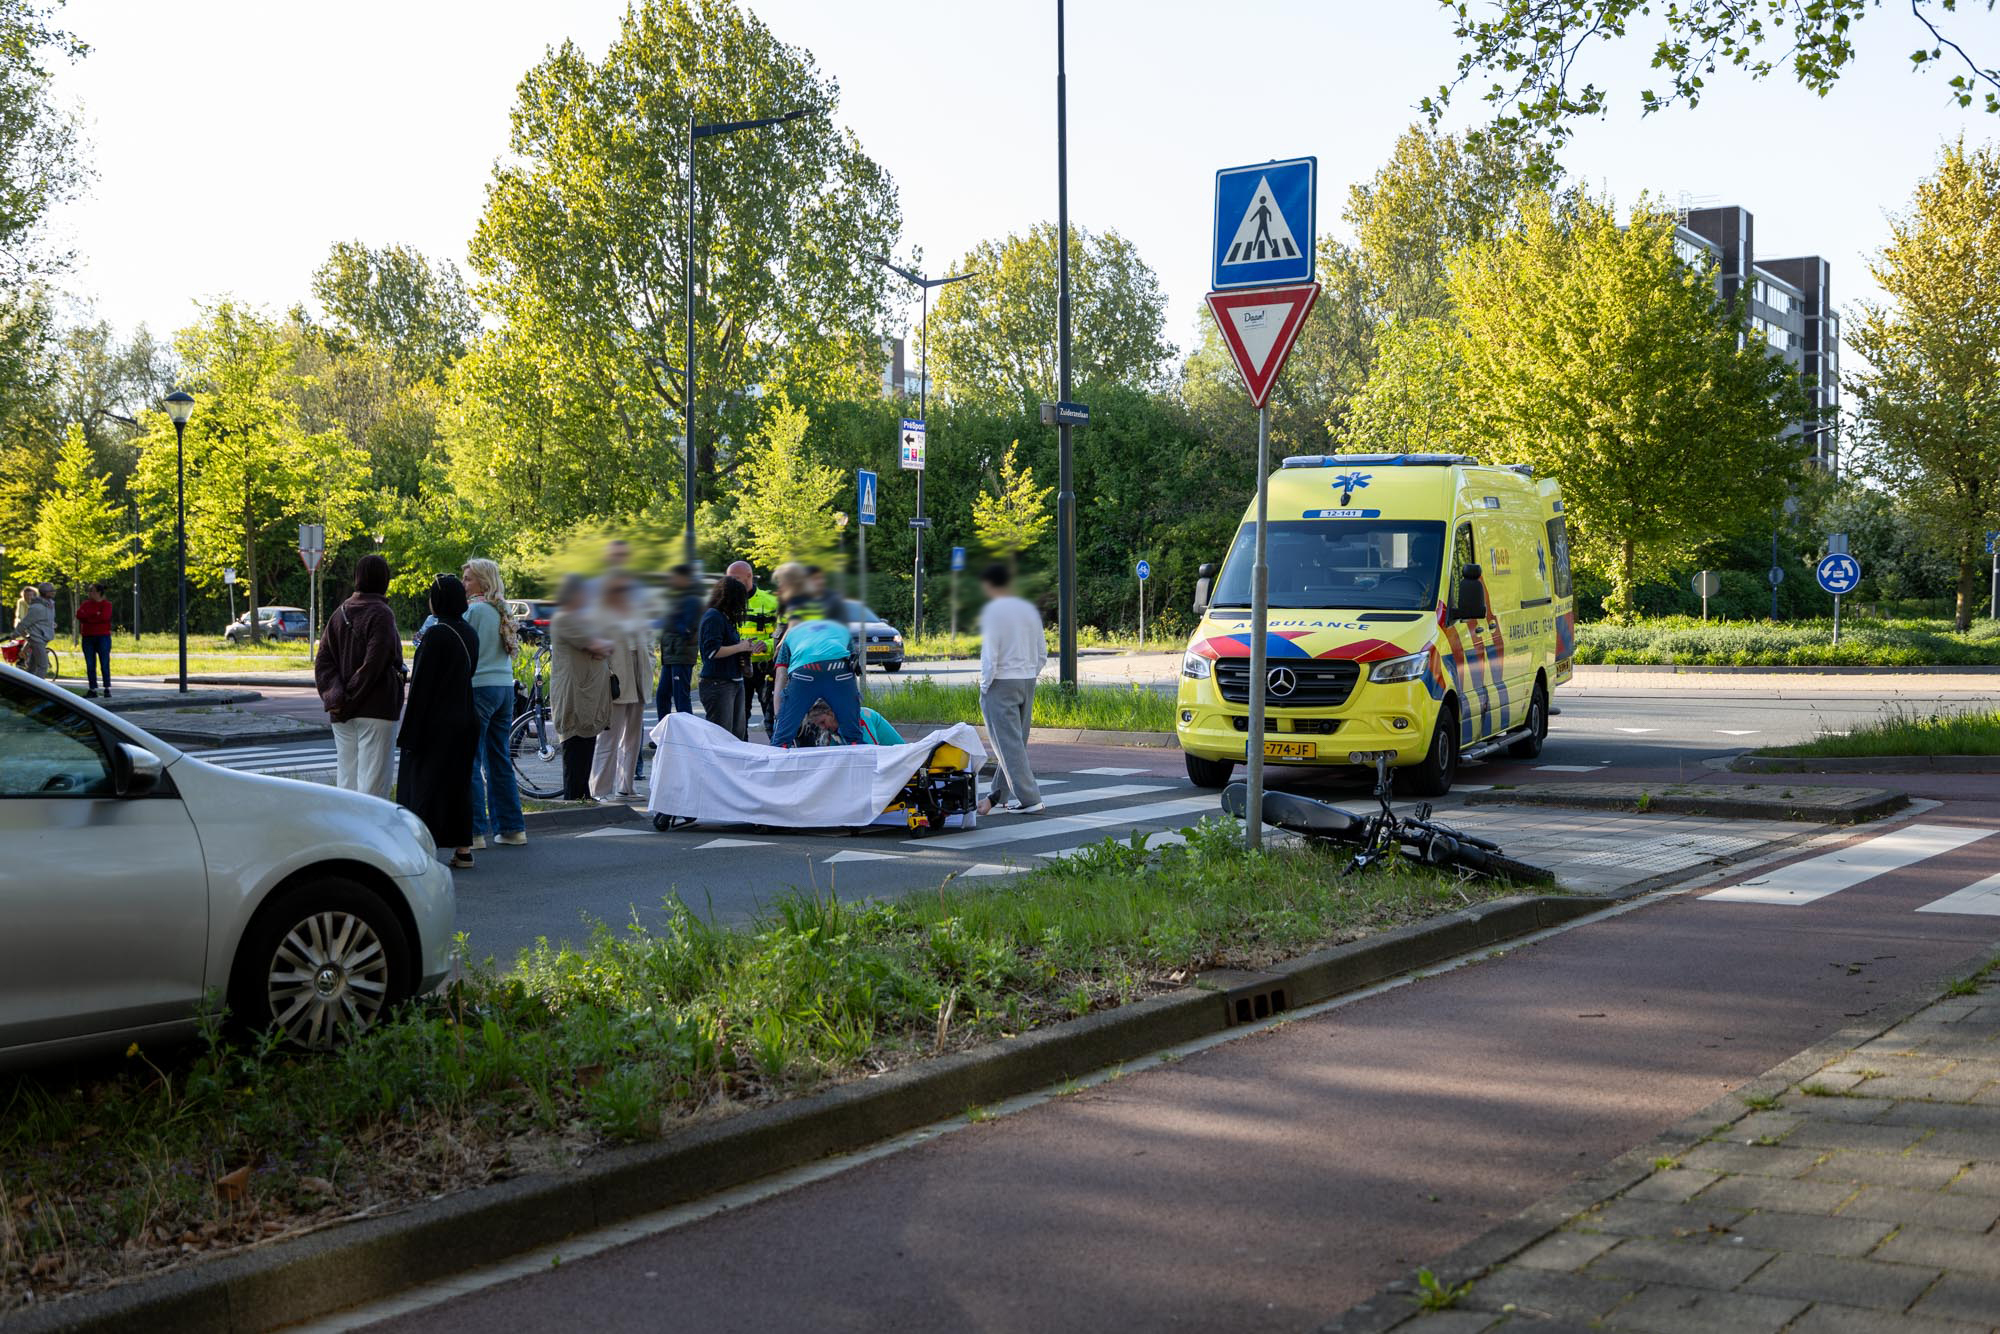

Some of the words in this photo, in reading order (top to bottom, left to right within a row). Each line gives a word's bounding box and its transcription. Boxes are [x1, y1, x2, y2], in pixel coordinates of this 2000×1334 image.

[1232, 620, 1371, 631] ABULANCE
[1509, 620, 1539, 641] AMBULANCE
[1263, 743, 1309, 756] -774-JF
